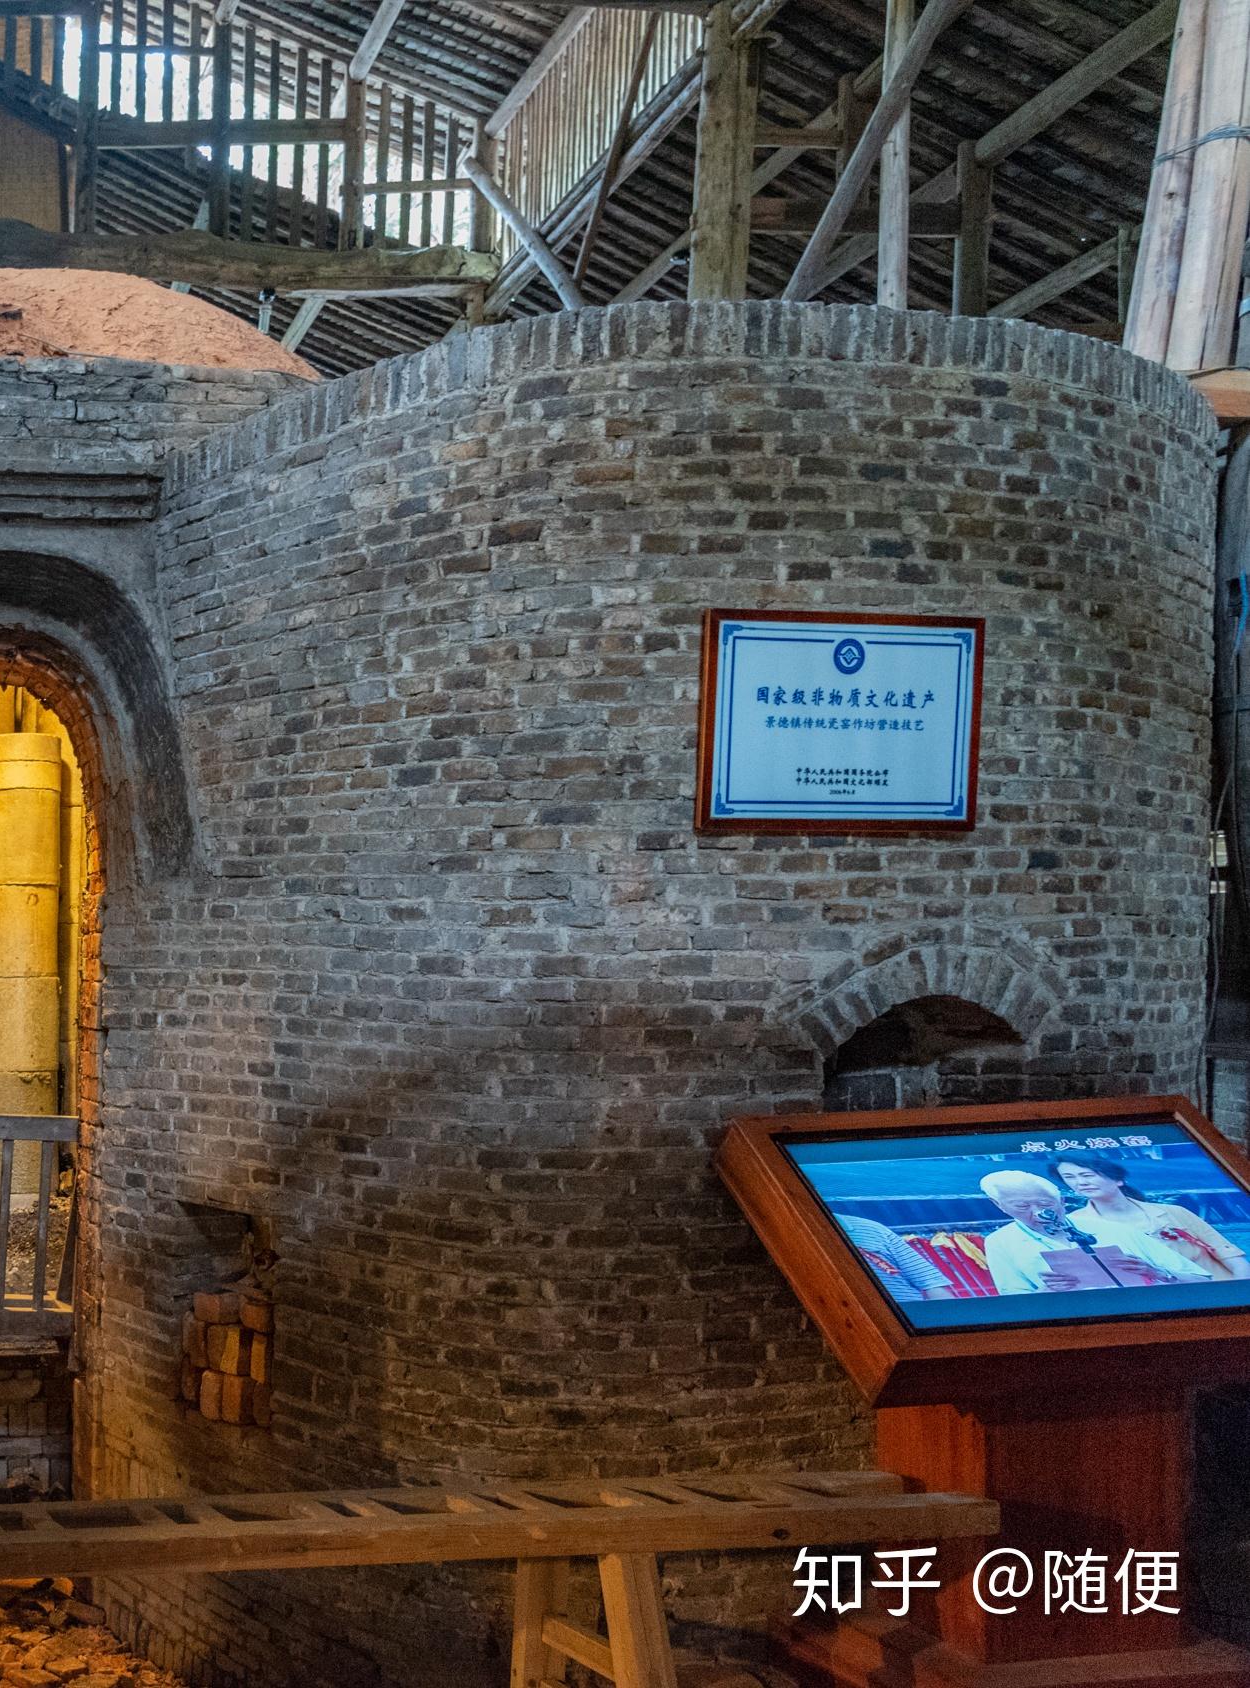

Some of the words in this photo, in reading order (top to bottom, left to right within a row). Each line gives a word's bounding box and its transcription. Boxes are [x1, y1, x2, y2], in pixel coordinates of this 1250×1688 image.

[756, 685, 935, 709] 国家级非物质文化遗产
[765, 715, 925, 732] 景德镇传统瓷窑作坊营造技艺
